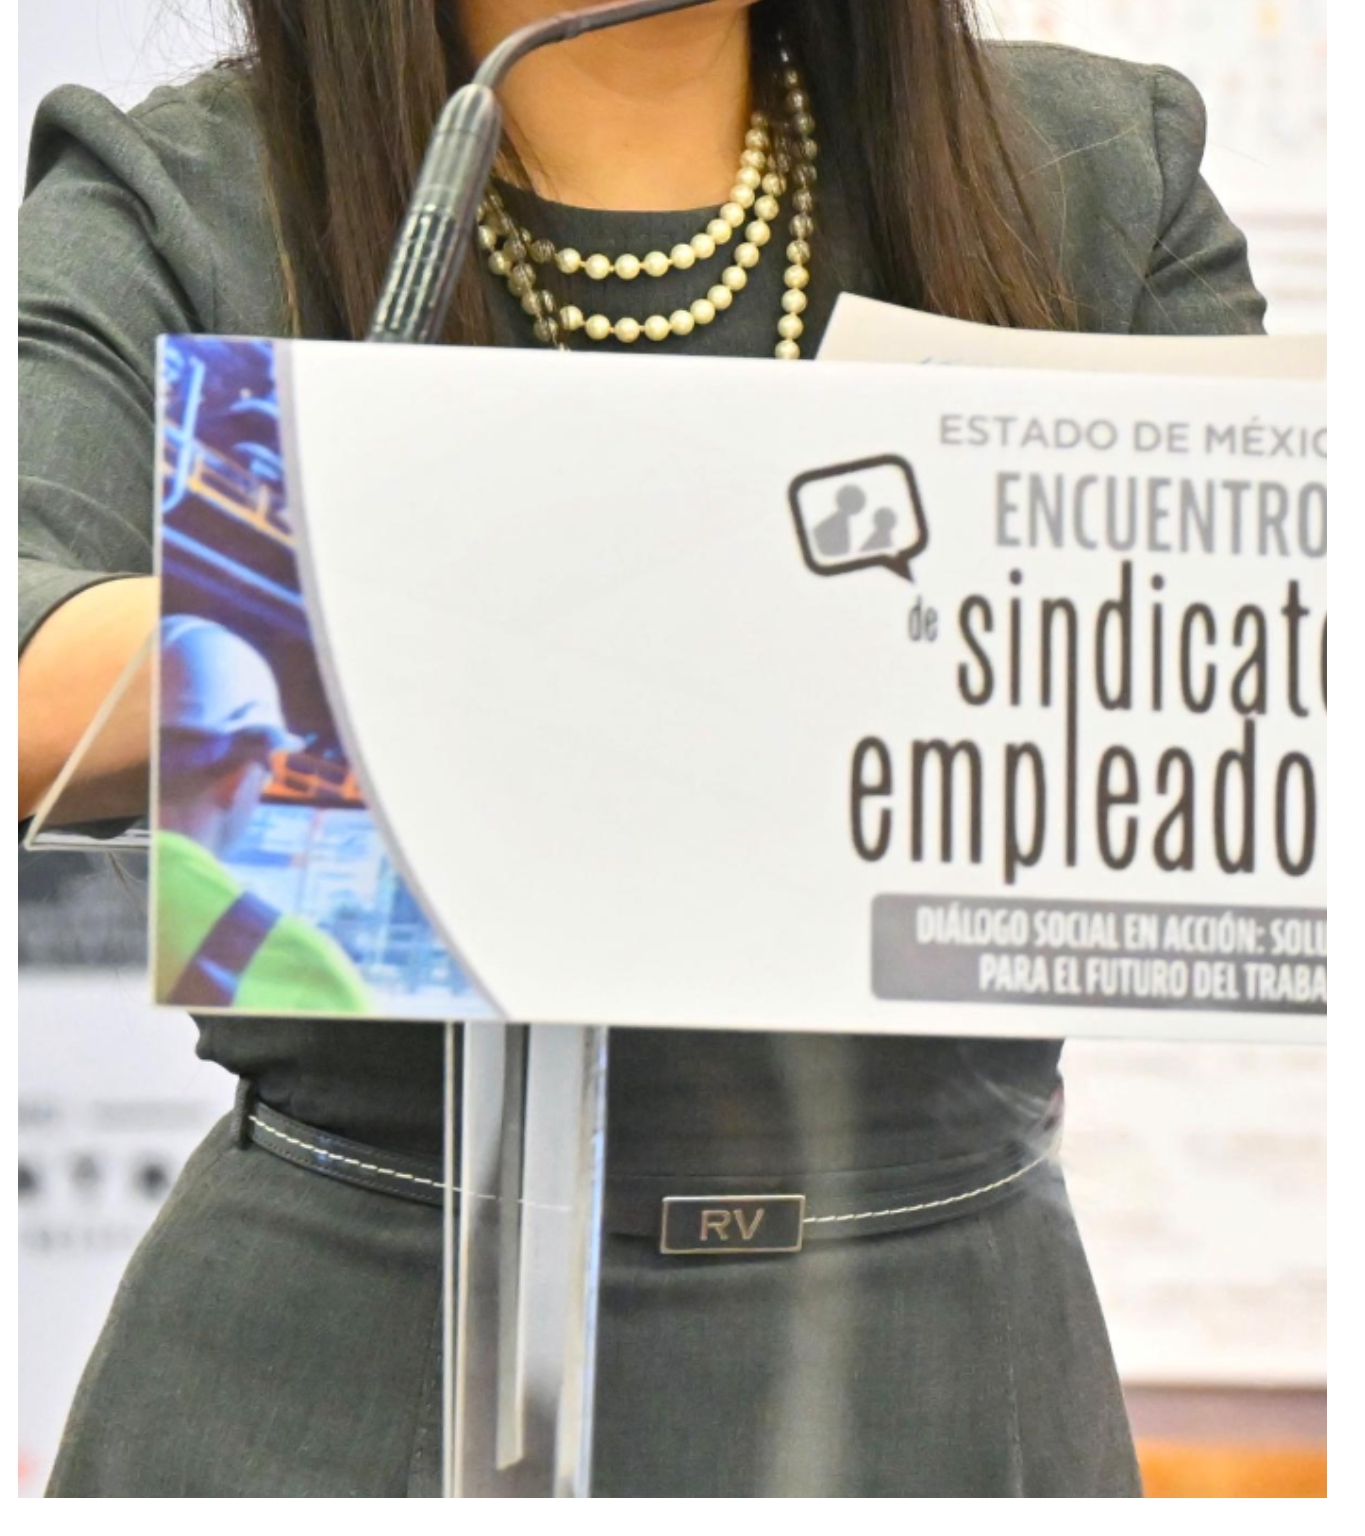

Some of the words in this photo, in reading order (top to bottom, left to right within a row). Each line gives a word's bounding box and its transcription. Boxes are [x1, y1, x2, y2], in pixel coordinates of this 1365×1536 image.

[939, 414, 1119, 454] ESTADO
[1133, 421, 1189, 455] DE
[994, 471, 1327, 562] ENCUENTRO
[907, 594, 939, 644] de
[956, 559, 1327, 719] sindicat
[848, 718, 1319, 886] empleado
[916, 902, 1029, 945] DIÁLOGO
[1033, 911, 1120, 950] SOCIAL
[1124, 913, 1157, 951] EN
[1163, 912, 1266, 955] ACCIÓN:
[978, 953, 1051, 994] PARA
[1053, 955, 1082, 995] EL
[1086, 956, 1188, 1000] FUTURO
[1192, 961, 1241, 1001] DEL
[1244, 962, 1327, 1004] TRABA
[699, 1208, 766, 1241] RV
